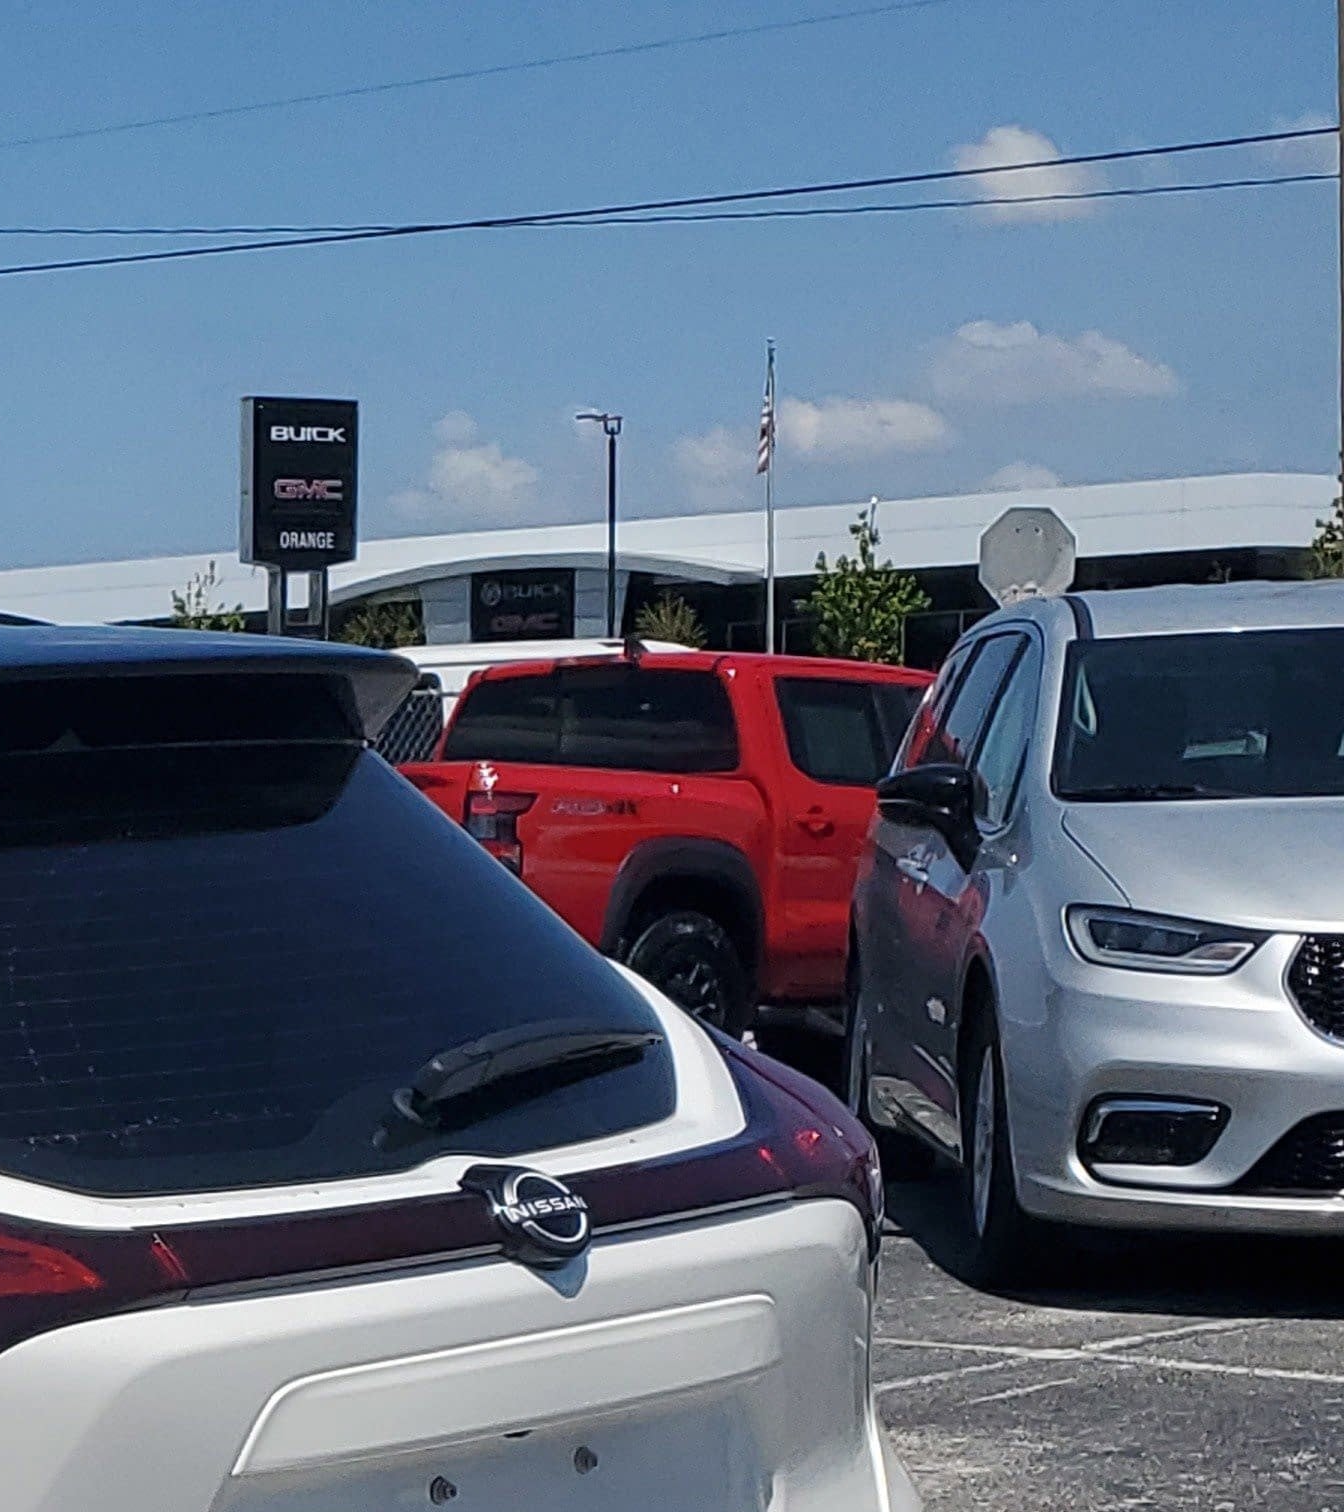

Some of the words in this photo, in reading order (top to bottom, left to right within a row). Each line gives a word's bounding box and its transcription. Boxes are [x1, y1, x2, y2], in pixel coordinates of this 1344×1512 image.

[270, 425, 347, 443] BUICK
[274, 478, 343, 500] GMC
[279, 531, 335, 549] ORANGE
[502, 1195, 588, 1223] NISSAN
